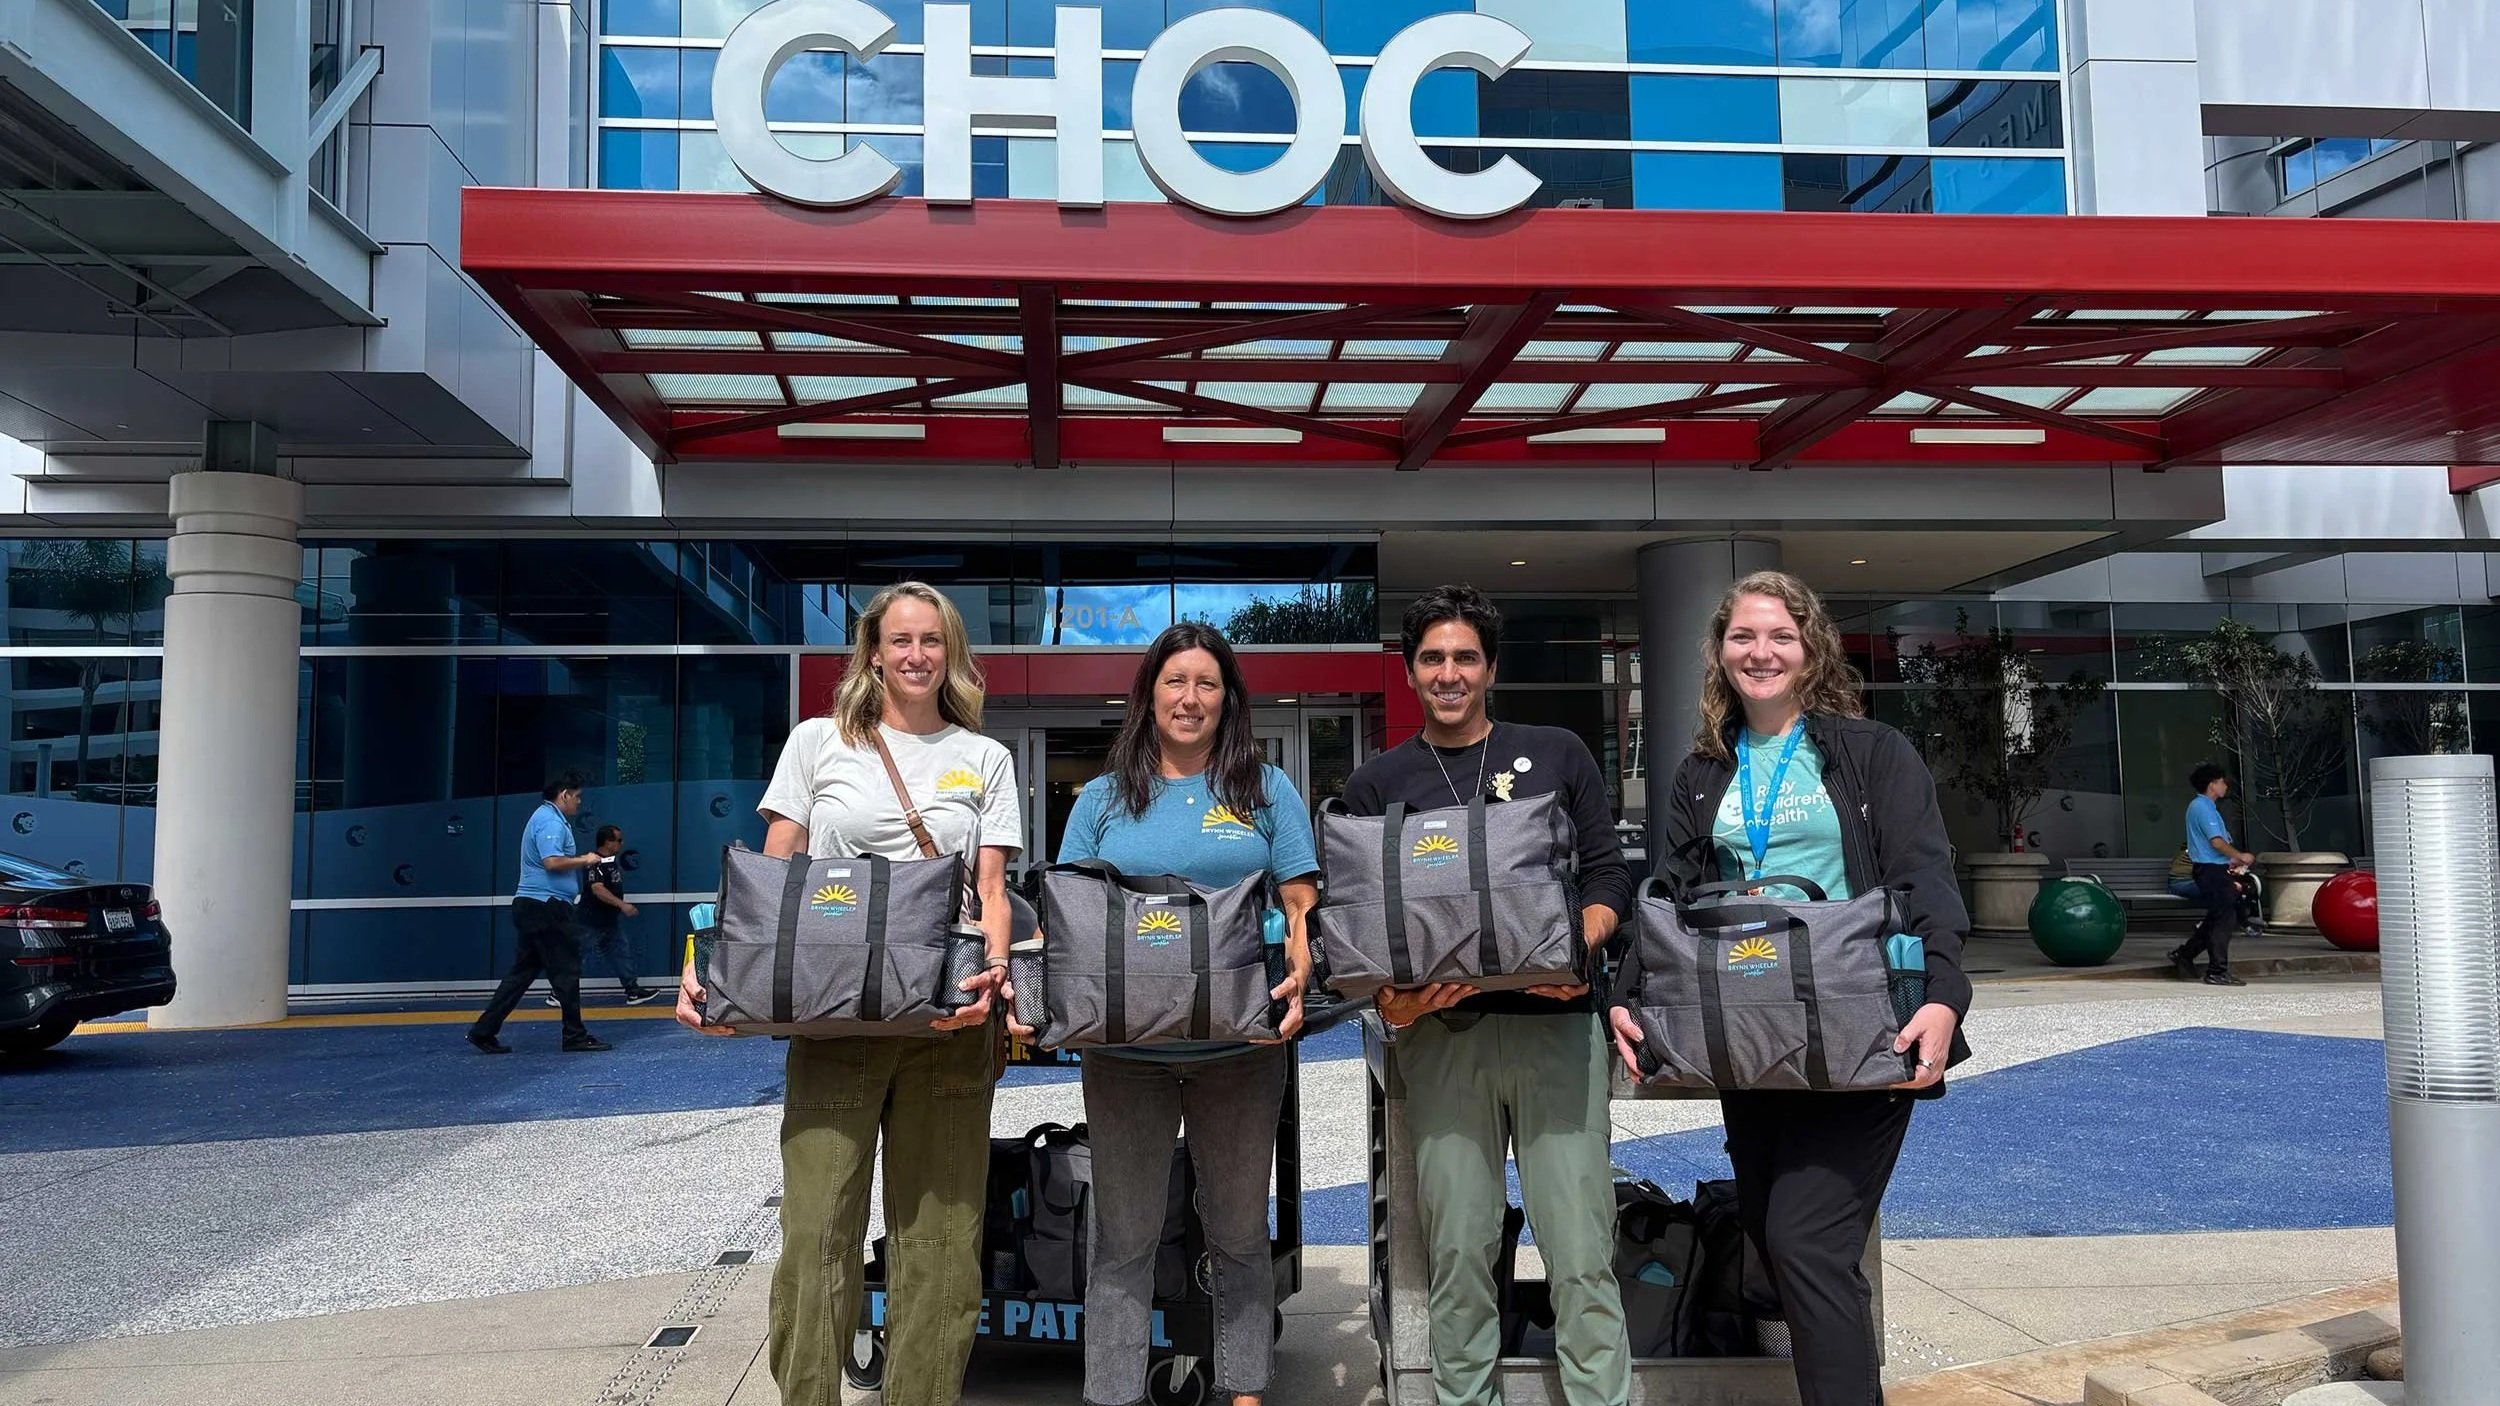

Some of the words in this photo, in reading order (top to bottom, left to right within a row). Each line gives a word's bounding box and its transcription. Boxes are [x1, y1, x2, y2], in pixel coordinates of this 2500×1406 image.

[711, 0, 1543, 219] CHOC
[1047, 604, 1141, 629] 1201-A
[1004, 1300, 1173, 1347] PATL
